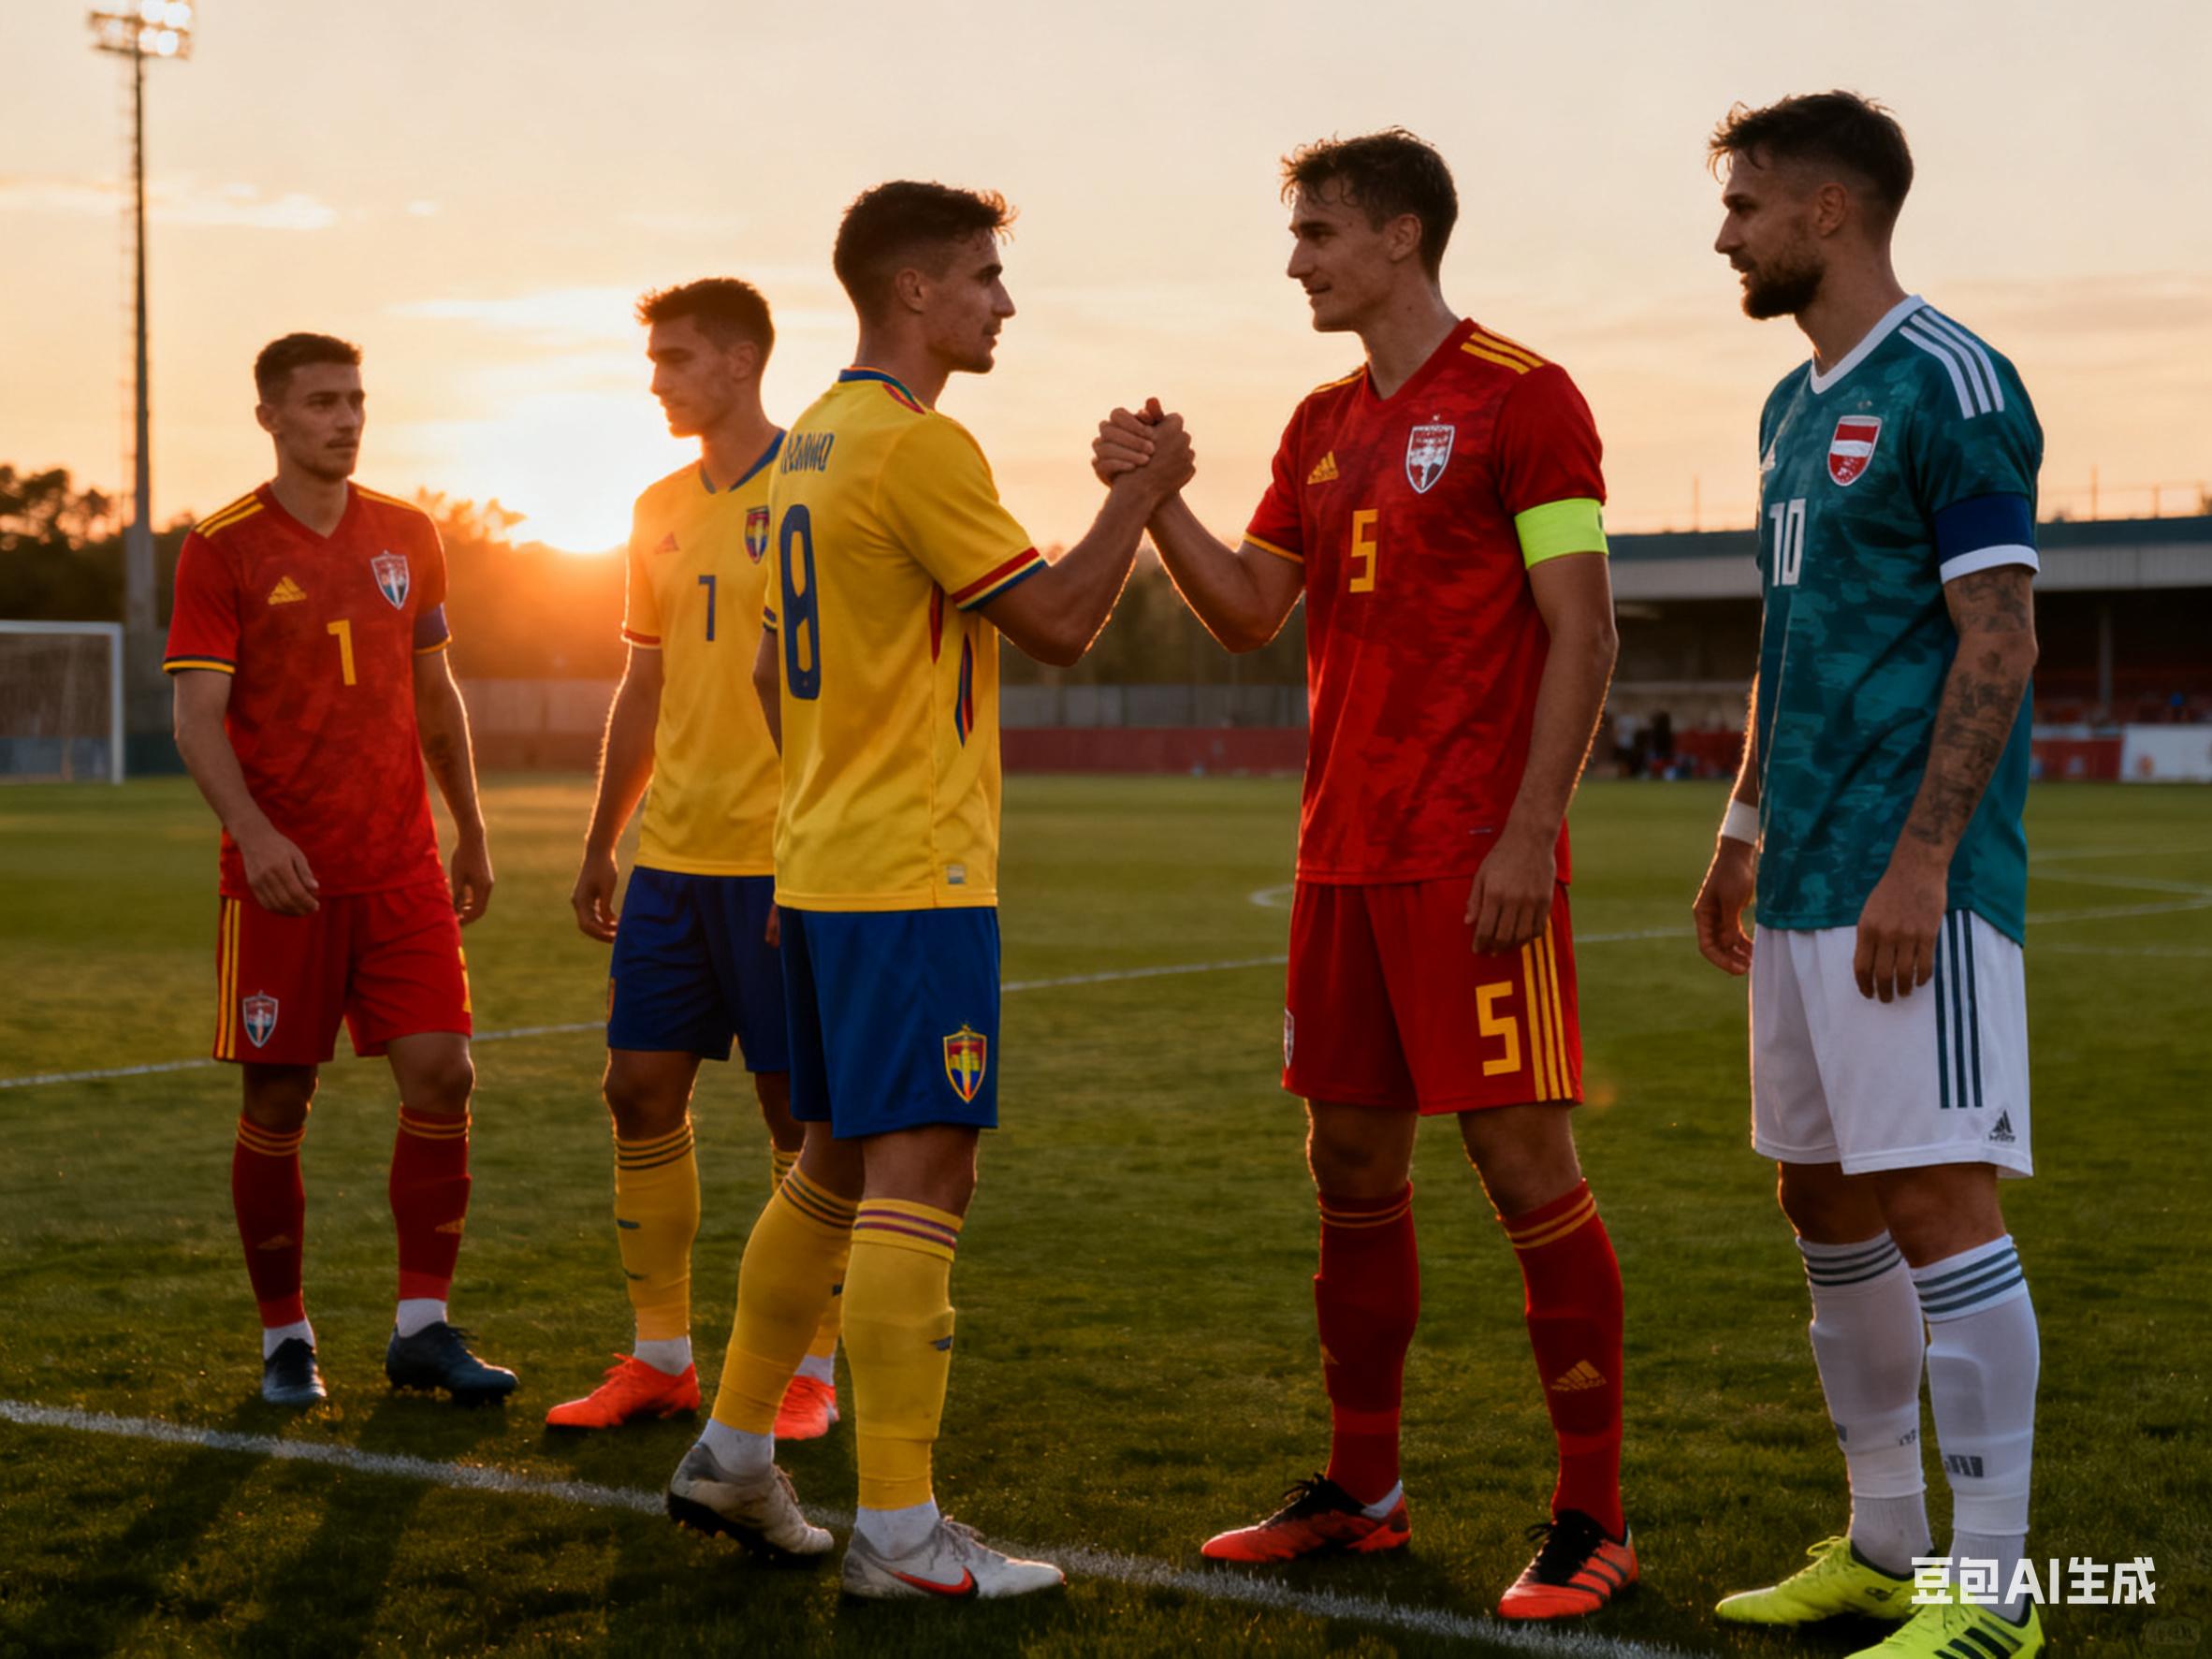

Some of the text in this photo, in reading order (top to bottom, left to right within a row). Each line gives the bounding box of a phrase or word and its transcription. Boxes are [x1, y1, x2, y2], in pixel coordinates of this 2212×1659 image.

[1349, 508, 1379, 593] 5
[1768, 498, 1807, 587] 10
[779, 503, 822, 700] 8
[327, 618, 357, 686] 1
[1476, 981, 1521, 1077] 5
